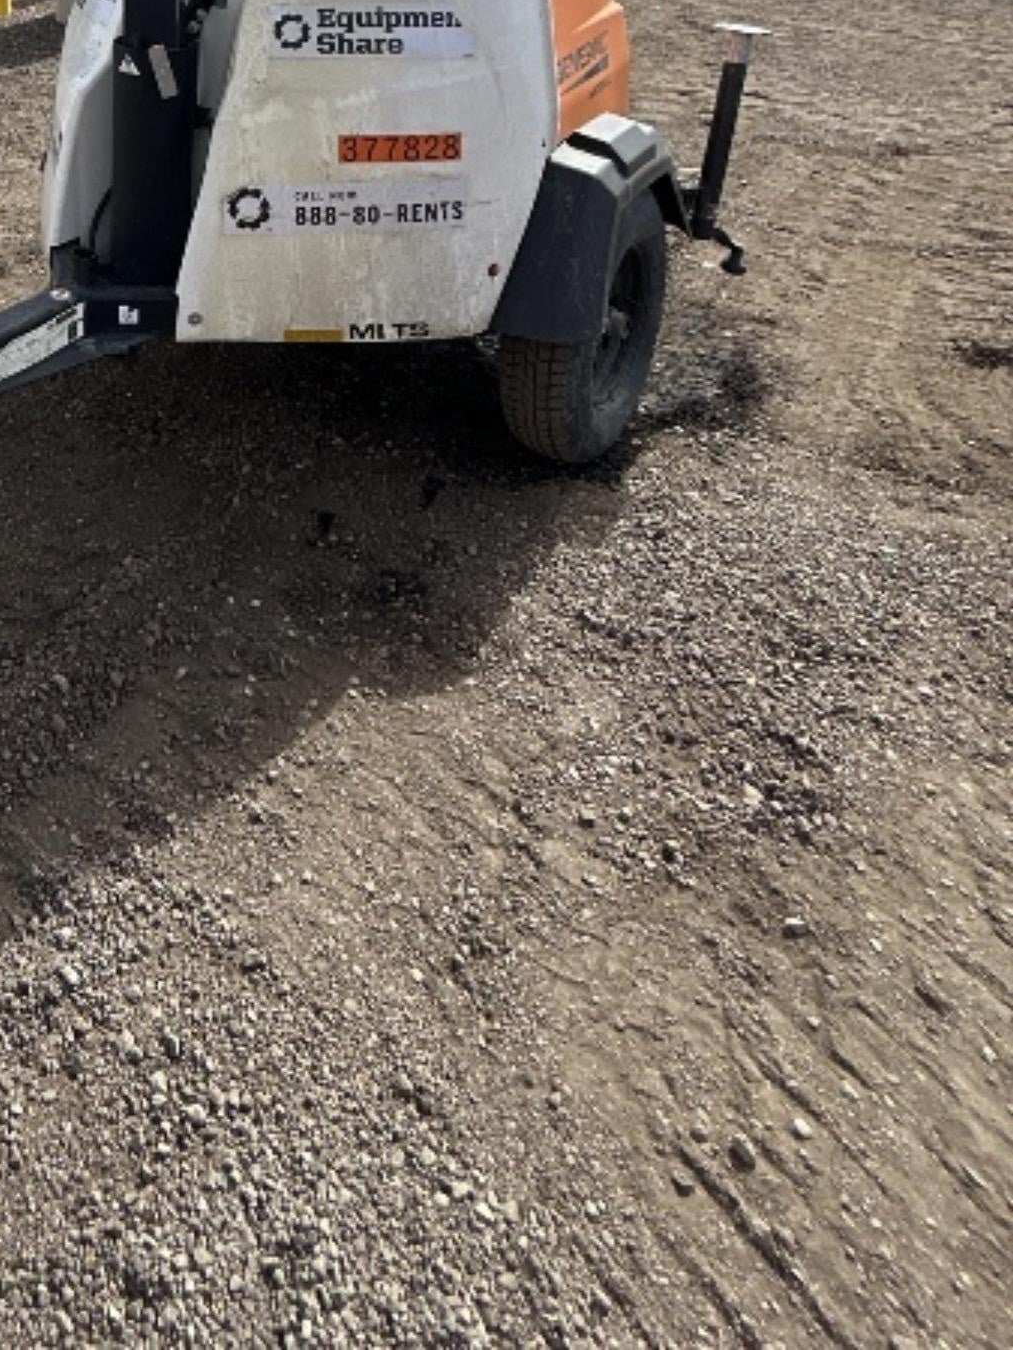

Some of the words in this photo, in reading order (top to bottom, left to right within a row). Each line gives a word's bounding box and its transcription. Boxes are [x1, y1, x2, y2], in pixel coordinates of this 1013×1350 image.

[317, 33, 403, 55] Share
[342, 135, 460, 162] 377828
[295, 200, 463, 226] 888-80-RENTS
